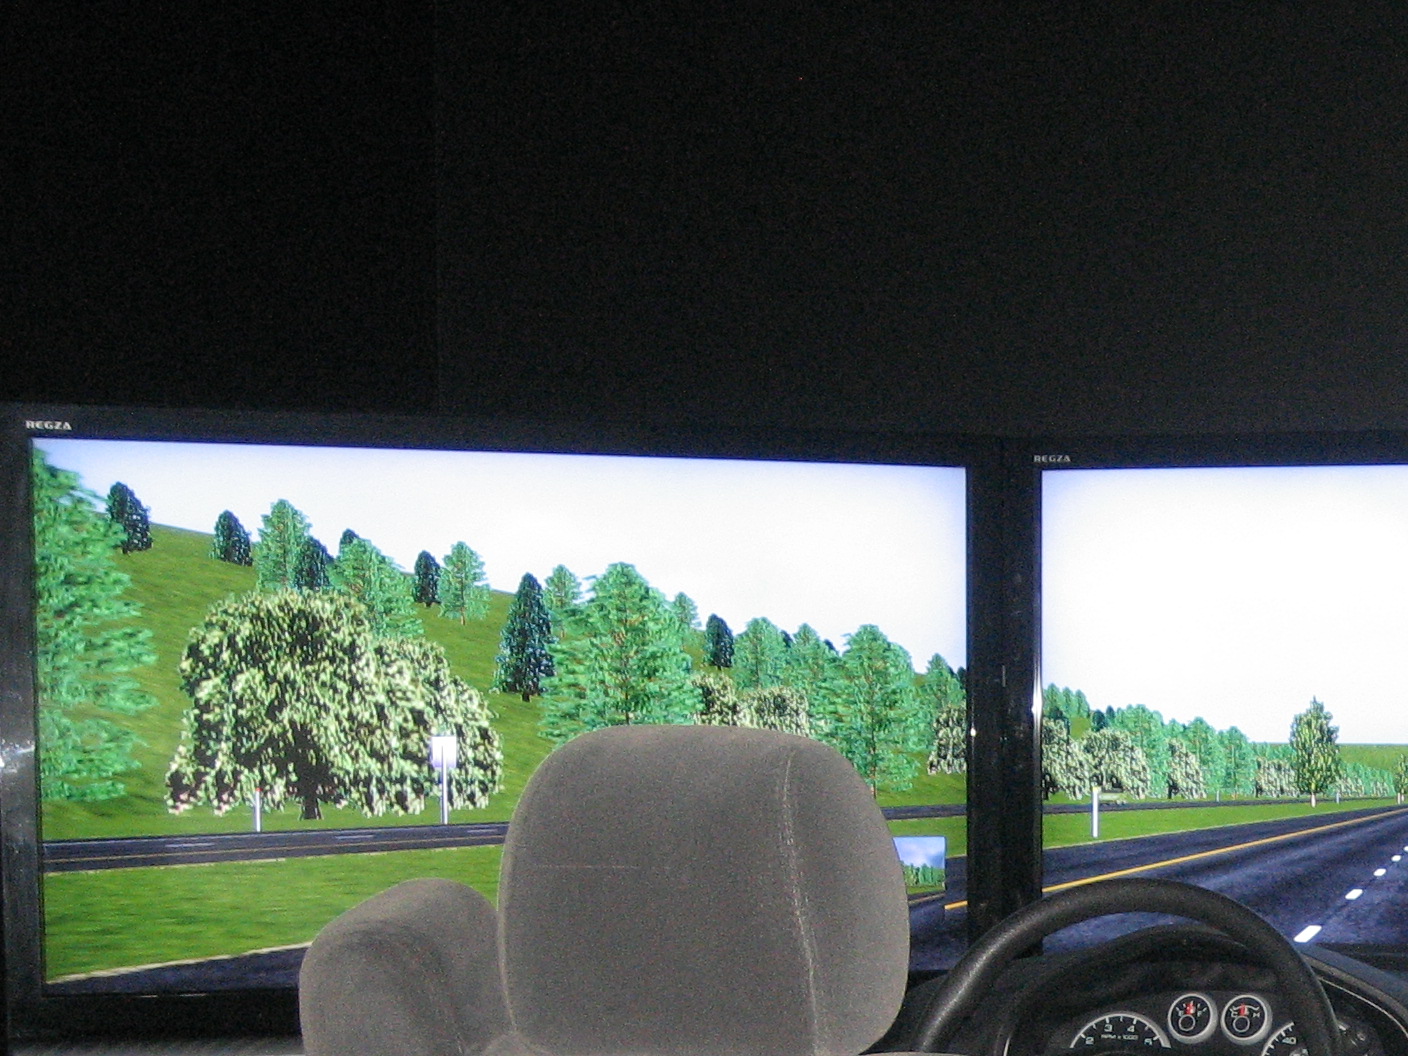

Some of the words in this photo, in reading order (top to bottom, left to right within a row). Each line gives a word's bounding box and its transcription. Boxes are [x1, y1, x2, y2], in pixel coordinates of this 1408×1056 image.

[25, 420, 72, 430] REGZA
[1033, 454, 1071, 463] REGZA
[1104, 1023, 1113, 1032] 3
[1127, 1025, 1135, 1033] 4
[1085, 1036, 1095, 1045] 2
[1282, 1037, 1297, 1045] 40
